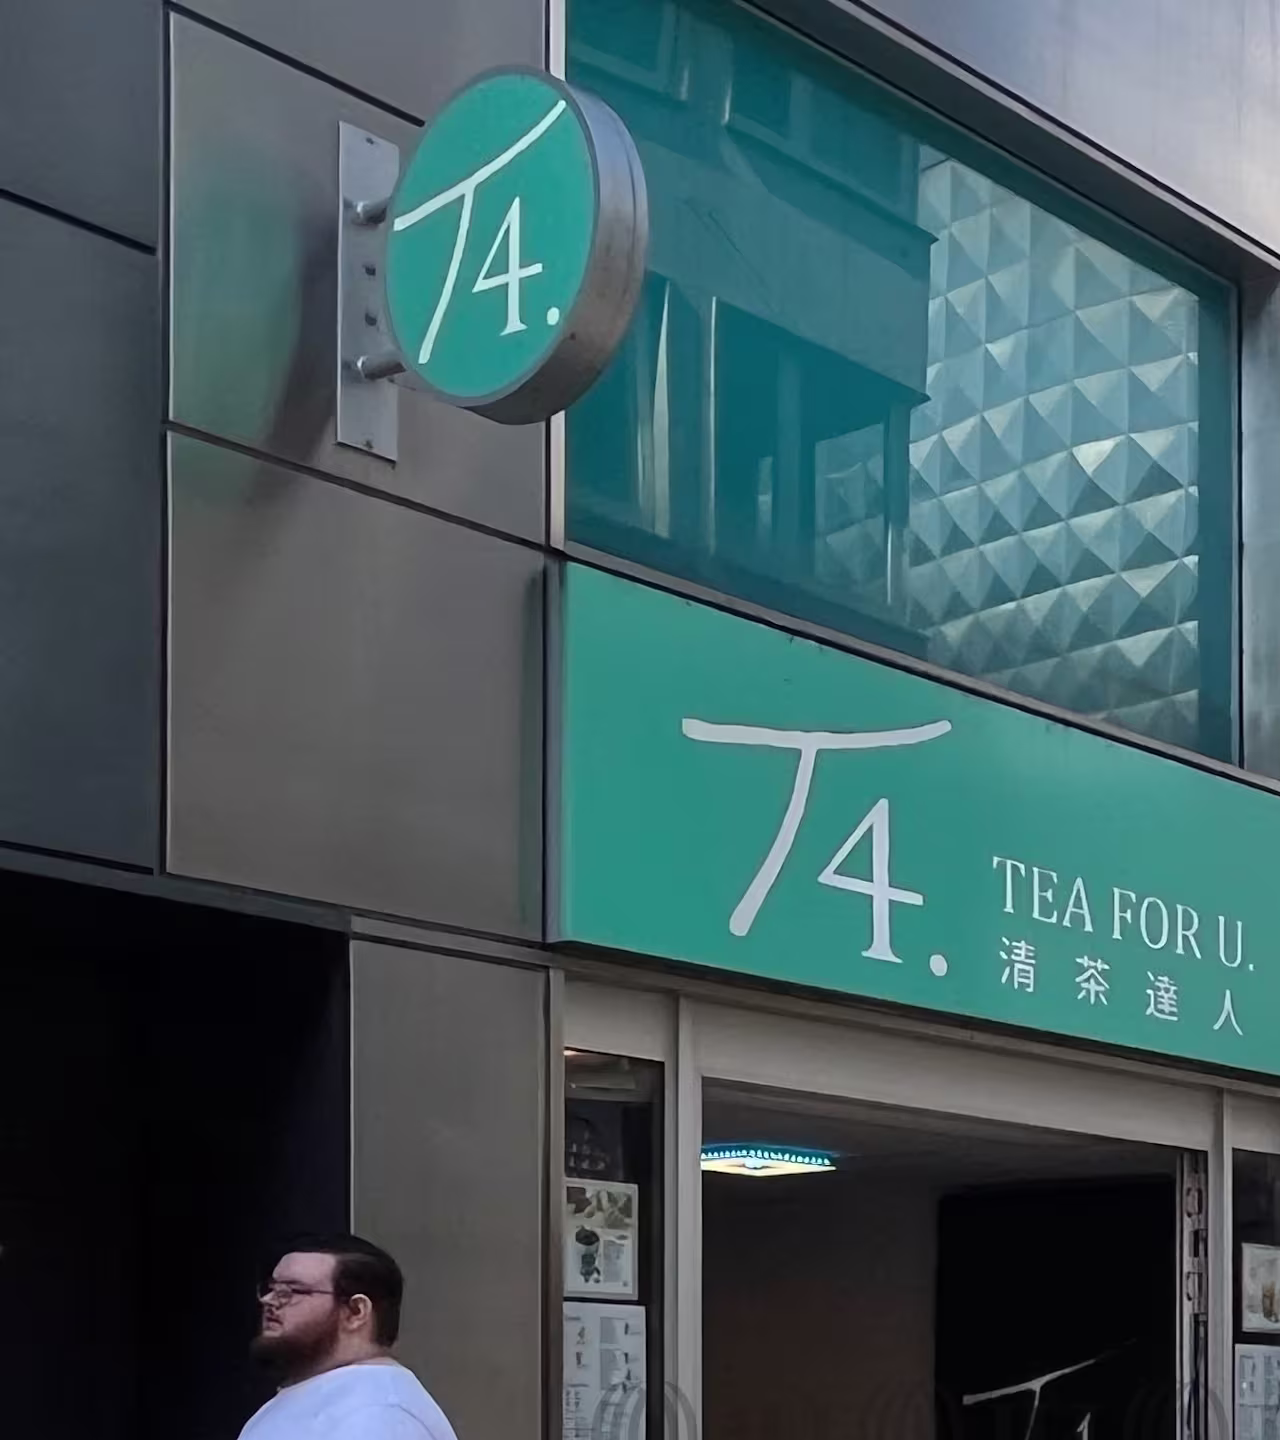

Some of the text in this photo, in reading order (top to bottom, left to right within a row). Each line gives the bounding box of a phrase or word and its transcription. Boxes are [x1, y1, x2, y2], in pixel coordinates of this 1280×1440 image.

[992, 855, 1256, 972] TEA FOR U.
